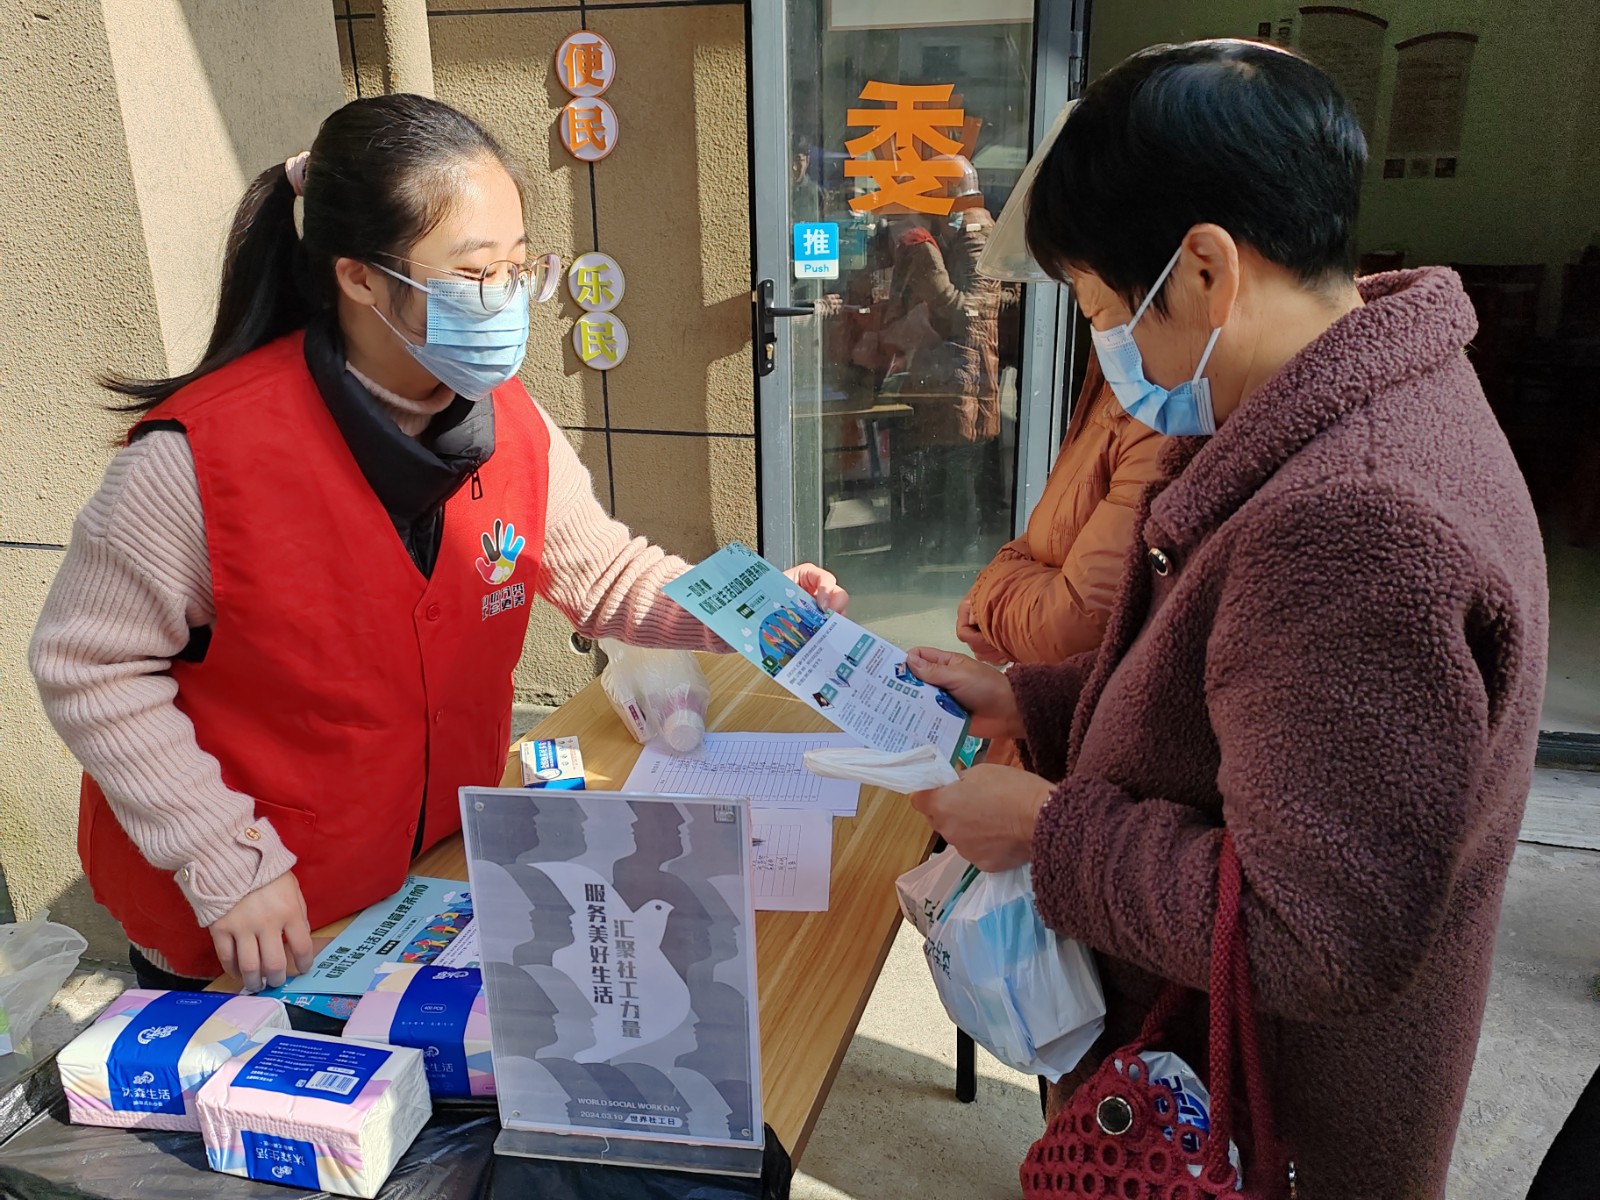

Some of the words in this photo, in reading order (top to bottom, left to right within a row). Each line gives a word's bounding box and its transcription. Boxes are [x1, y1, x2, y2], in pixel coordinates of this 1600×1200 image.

[563, 41, 607, 152] 便民
[844, 79, 965, 216] 委
[803, 228, 831, 256] 推
[803, 263, 830, 274] Push
[577, 263, 618, 362] 乐民
[584, 883, 614, 1005] 服务美好生活
[613, 919, 642, 1039] 汇聚社工力量
[577, 1098, 607, 1106] WORLD
[608, 1100, 637, 1109] SOCIAL
[637, 1103, 662, 1111] WORK
[630, 1115, 675, 1126] 世界社工日
